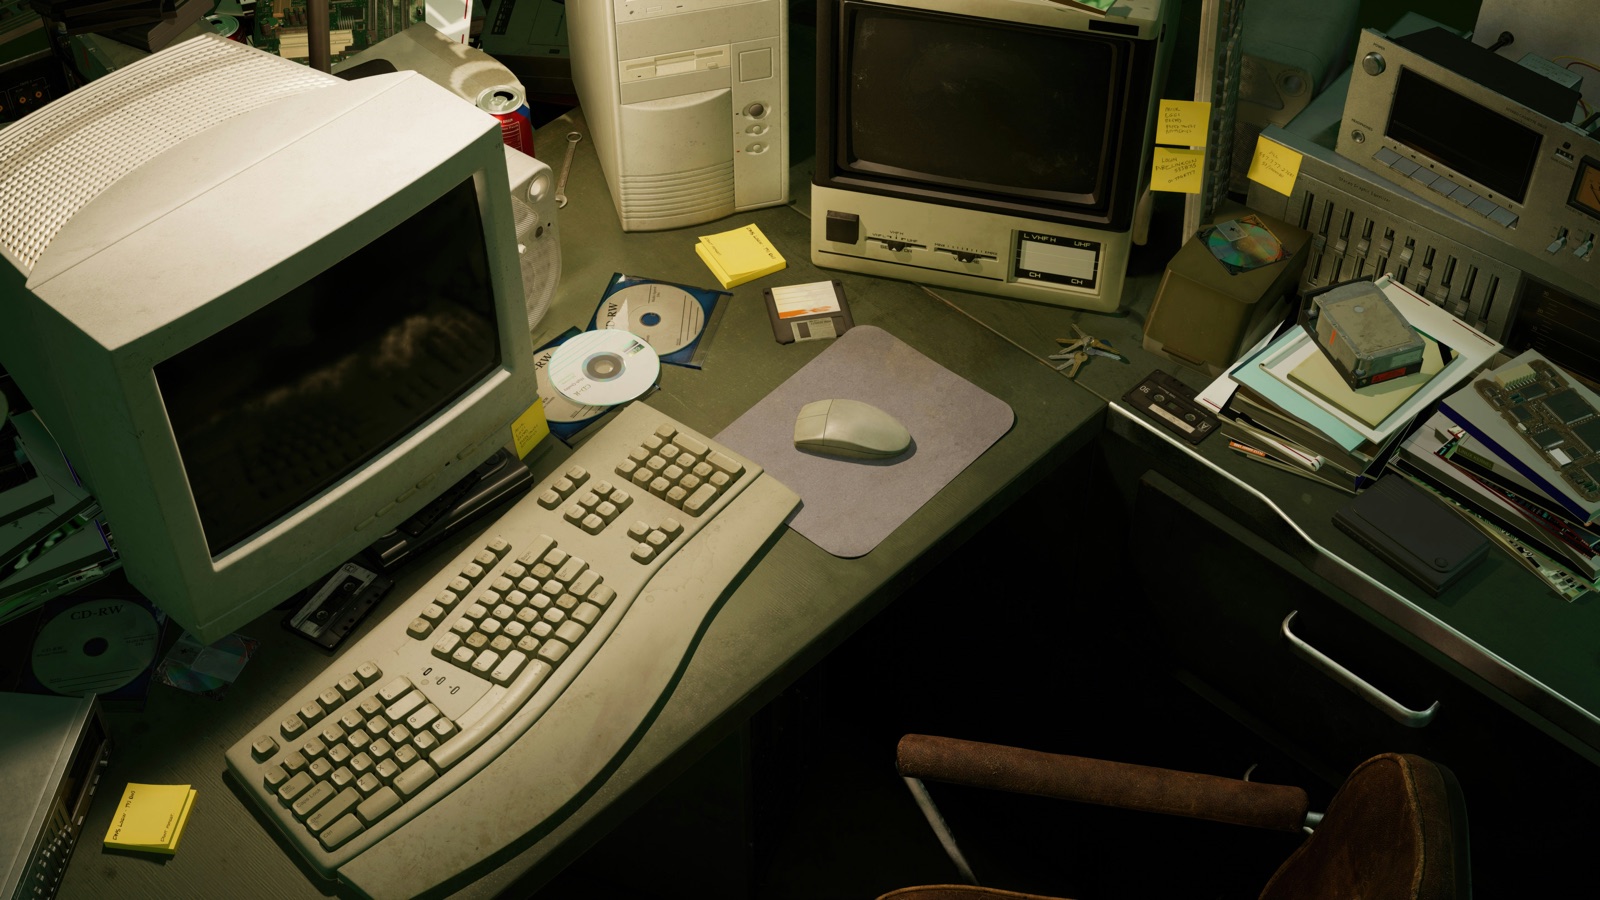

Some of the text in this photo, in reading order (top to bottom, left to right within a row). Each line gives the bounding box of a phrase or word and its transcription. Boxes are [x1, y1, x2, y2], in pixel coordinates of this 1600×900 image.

[1031, 234, 1049, 242] VHF
[1073, 240, 1091, 248] UHF
[1029, 271, 1041, 279] CH
[70, 604, 125, 621] CD-RW
[296, 787, 321, 808] Caps Lock
[323, 830, 333, 838] Ctrl
